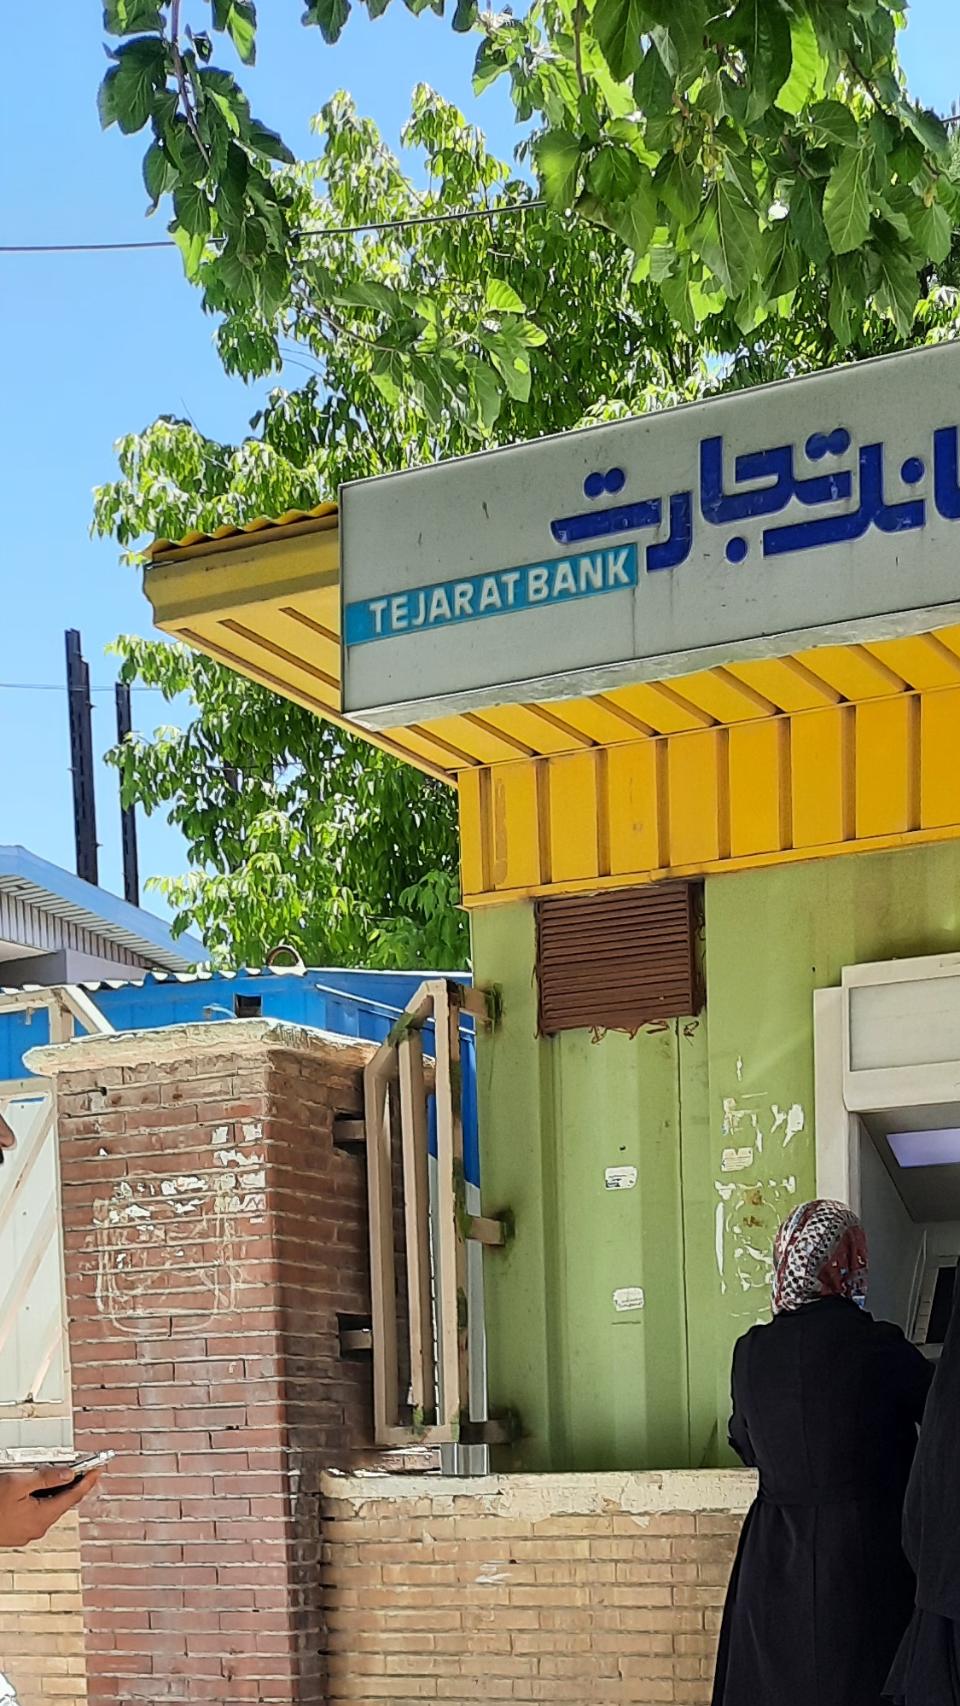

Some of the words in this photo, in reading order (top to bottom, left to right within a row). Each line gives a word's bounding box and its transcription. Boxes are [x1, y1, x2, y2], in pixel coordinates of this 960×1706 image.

[551, 427, 852, 573] تجارت
[369, 571, 521, 633] TEJARAT
[527, 548, 631, 602] BANK
